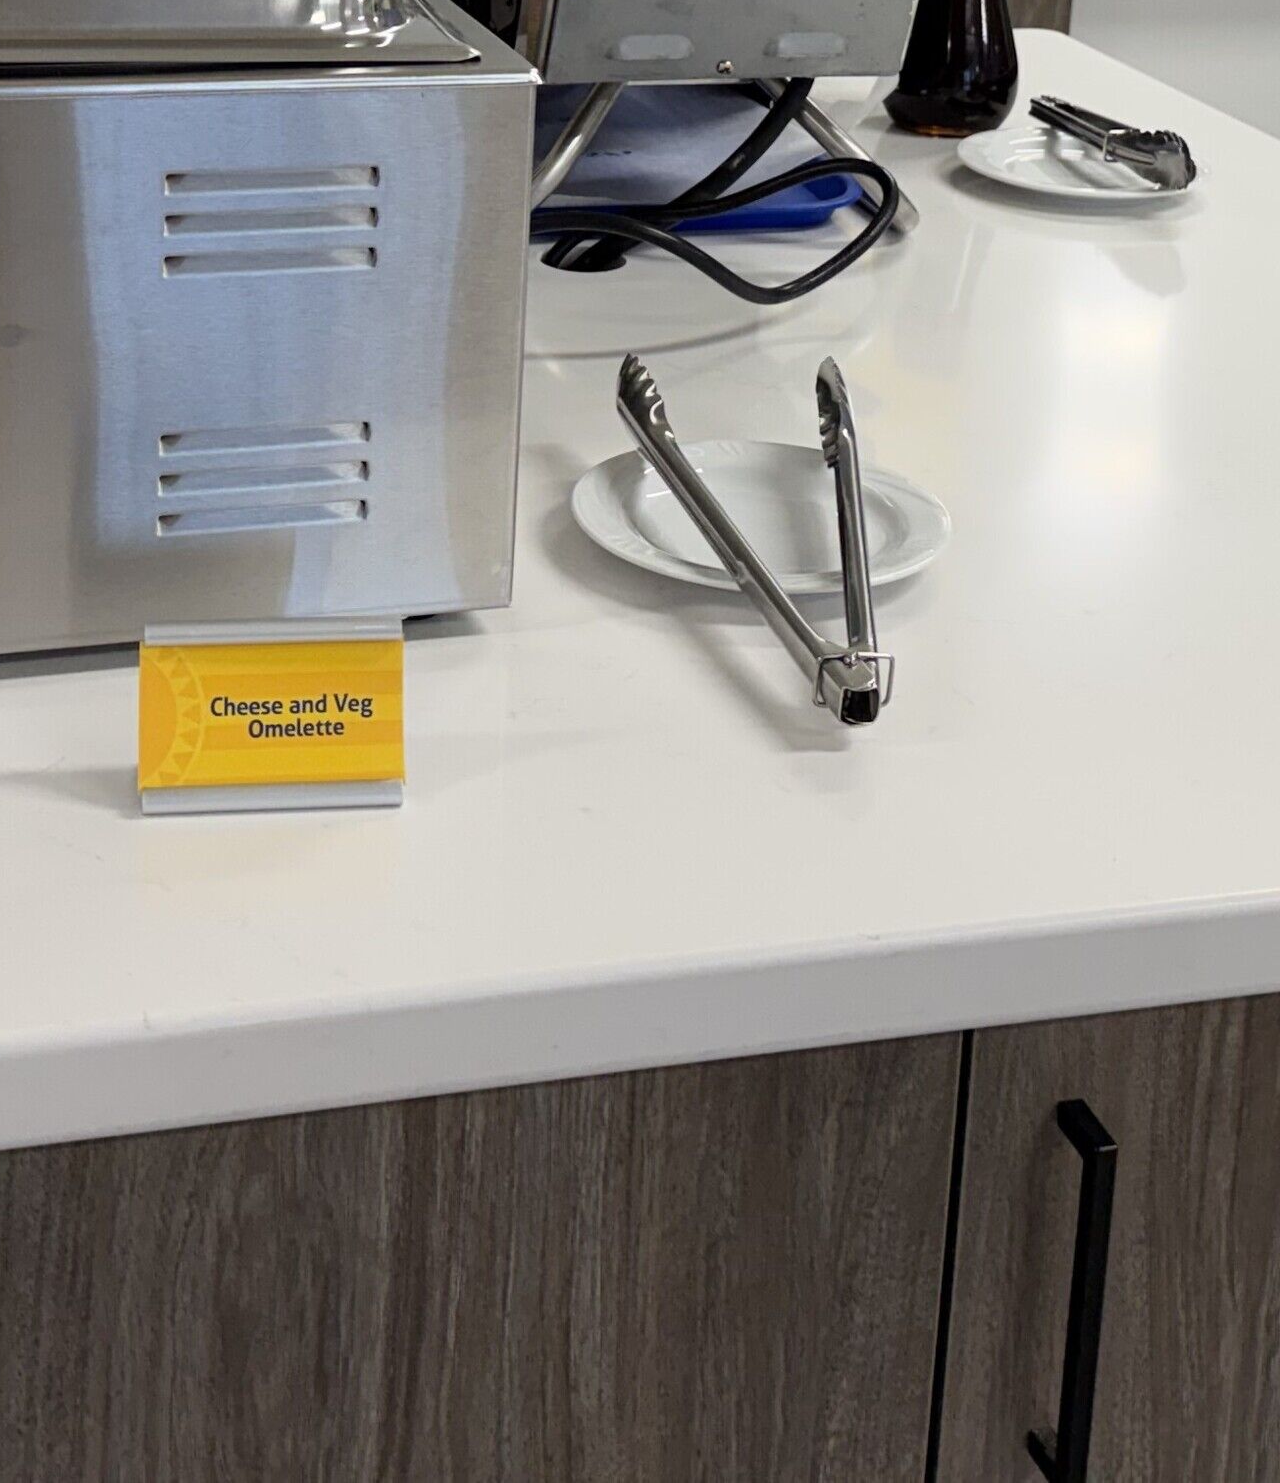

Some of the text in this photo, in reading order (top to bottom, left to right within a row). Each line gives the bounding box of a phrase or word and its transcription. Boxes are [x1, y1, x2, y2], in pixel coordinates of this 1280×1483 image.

[210, 692, 374, 717] Cheese and Veg
[248, 718, 345, 738] Omelette
